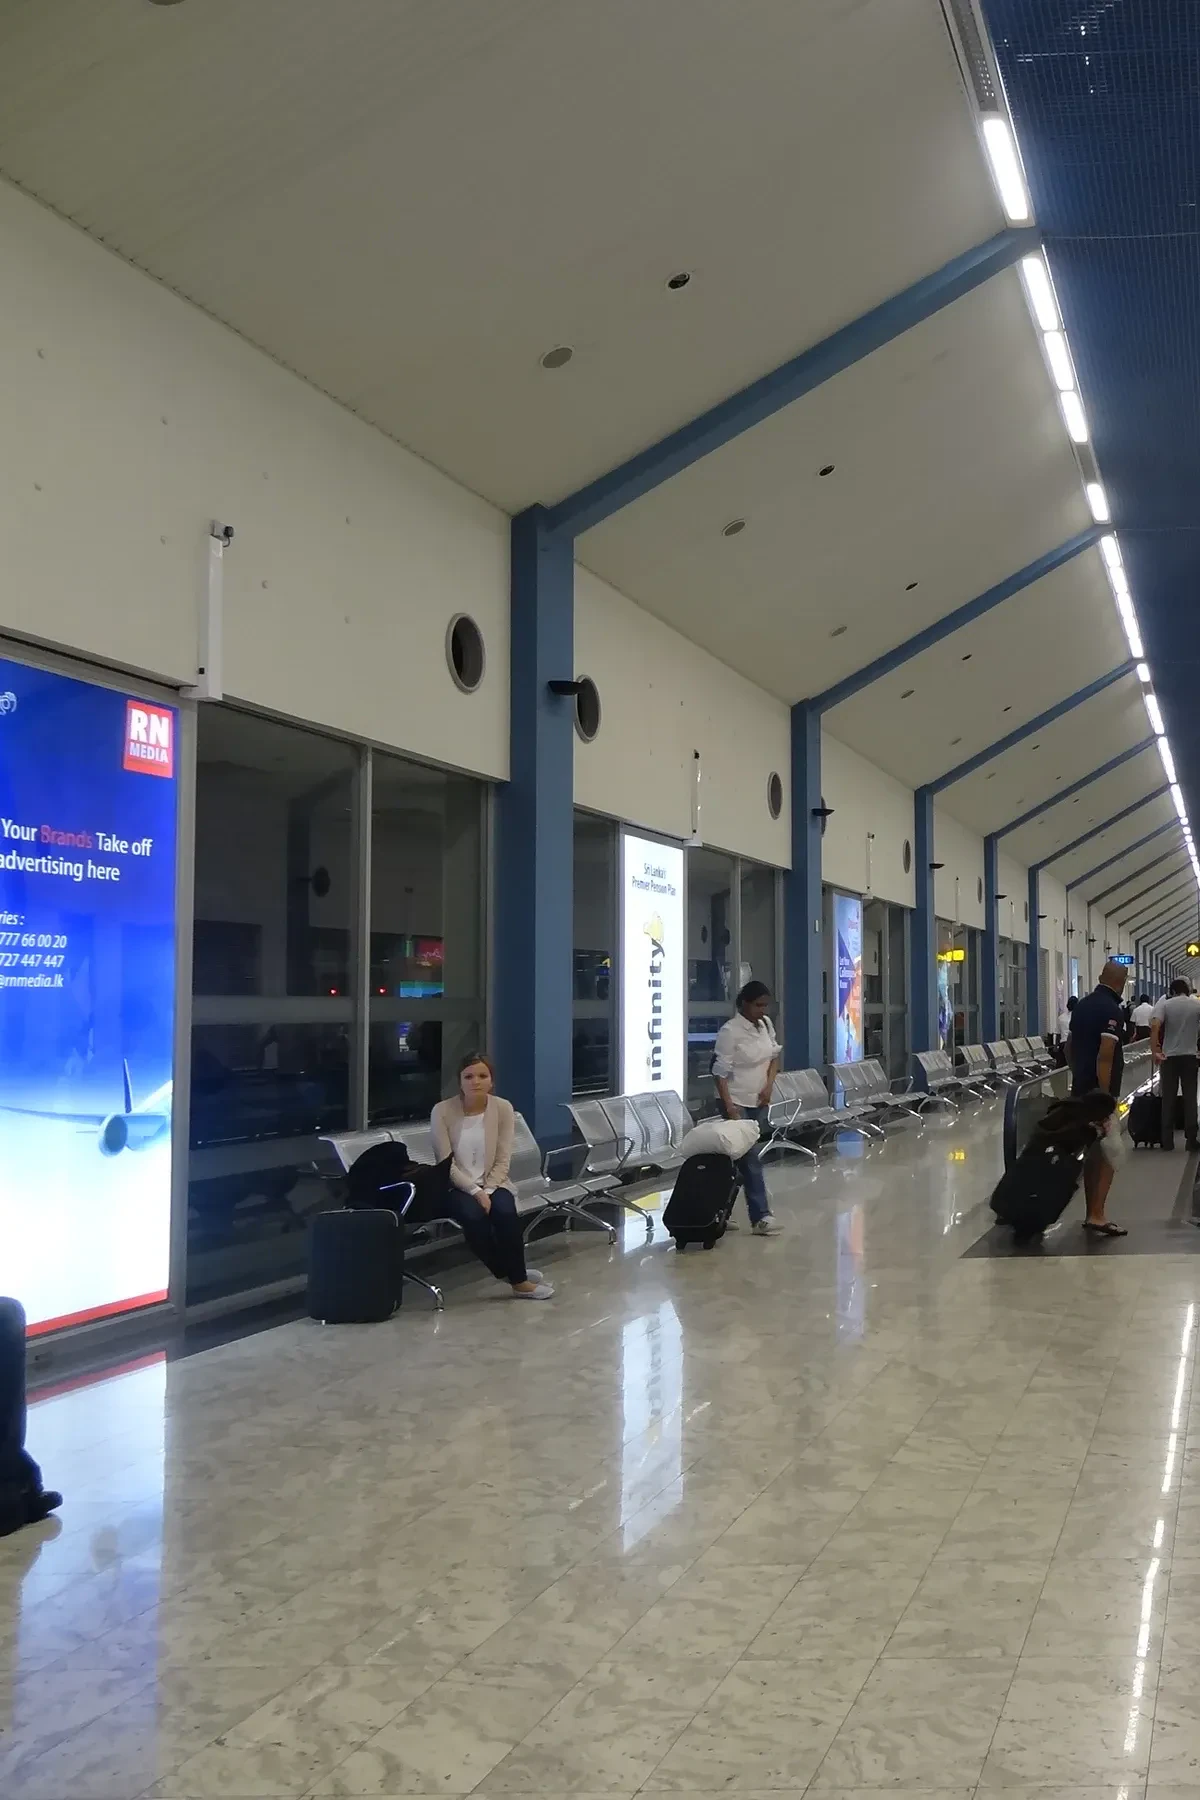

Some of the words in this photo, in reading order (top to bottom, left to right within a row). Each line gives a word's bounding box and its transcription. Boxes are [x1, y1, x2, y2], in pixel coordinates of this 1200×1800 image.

[130, 708, 169, 748] RN
[129, 742, 169, 763] MEDIA
[2, 818, 37, 842] Your
[40, 825, 93, 848] Brands
[96, 832, 129, 854] Take
[132, 838, 153, 857] off
[0, 850, 84, 882] advertising
[87, 860, 120, 881] here
[632, 875, 650, 891] Premier
[650, 879, 668, 894] Pension
[21, 933, 36, 947] 66
[37, 934, 52, 948] 00
[52, 935, 67, 948] 20
[20, 953, 42, 967] 447
[43, 954, 65, 968] 447
[647, 938, 665, 1081] infinity
